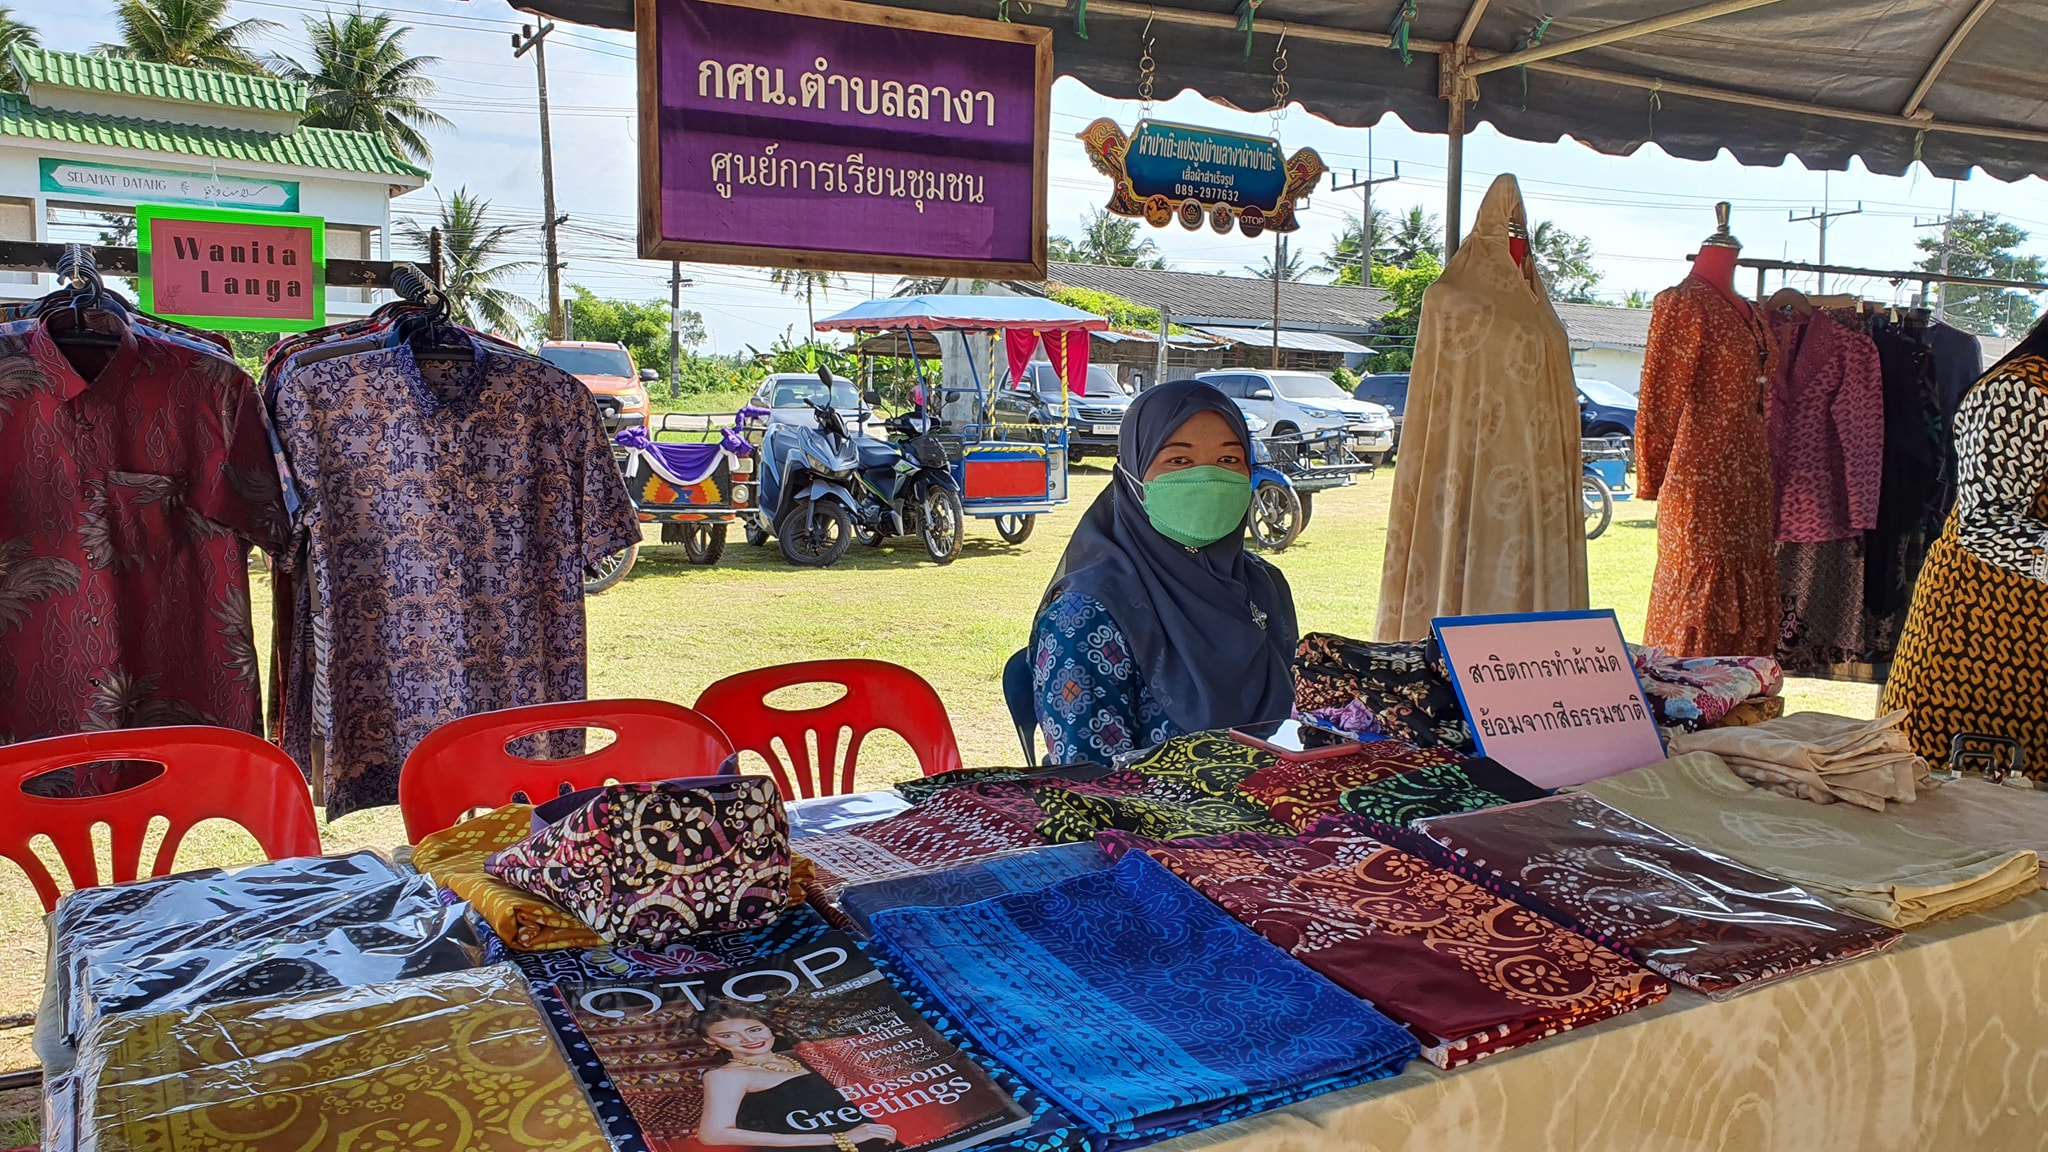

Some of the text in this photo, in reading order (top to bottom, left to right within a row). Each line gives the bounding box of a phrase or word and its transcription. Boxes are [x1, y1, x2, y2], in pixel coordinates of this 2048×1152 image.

[697, 56, 996, 127] กศน.ตำบลลางา
[67, 171, 167, 191] SELAMAT DATANG
[710, 143, 985, 214] ศูนย์การเรียนชุมชน
[1174, 183, 1239, 202] 089-2977632
[1240, 215, 1264, 226] OTOP
[172, 236, 297, 267] Wanita
[201, 270, 301, 303] Langa
[1468, 646, 1622, 684] สาธิตการทำผ้ามัด
[1480, 693, 1647, 738] ย้อมจากสีธรรมชาติ
[579, 946, 849, 1019] OTOP
[810, 976, 871, 999] Prestige
[829, 1010, 897, 1033] Unique Thai
[836, 1004, 891, 1024] Beautifully
[856, 1015, 906, 1036] Local
[844, 1025, 913, 1048] Textiles
[860, 1037, 925, 1063] Jewelry
[903, 1050, 940, 1066] Mood
[904, 1045, 933, 1057] Your
[834, 1061, 957, 1102] Blossom
[785, 1075, 973, 1131] Greetings
